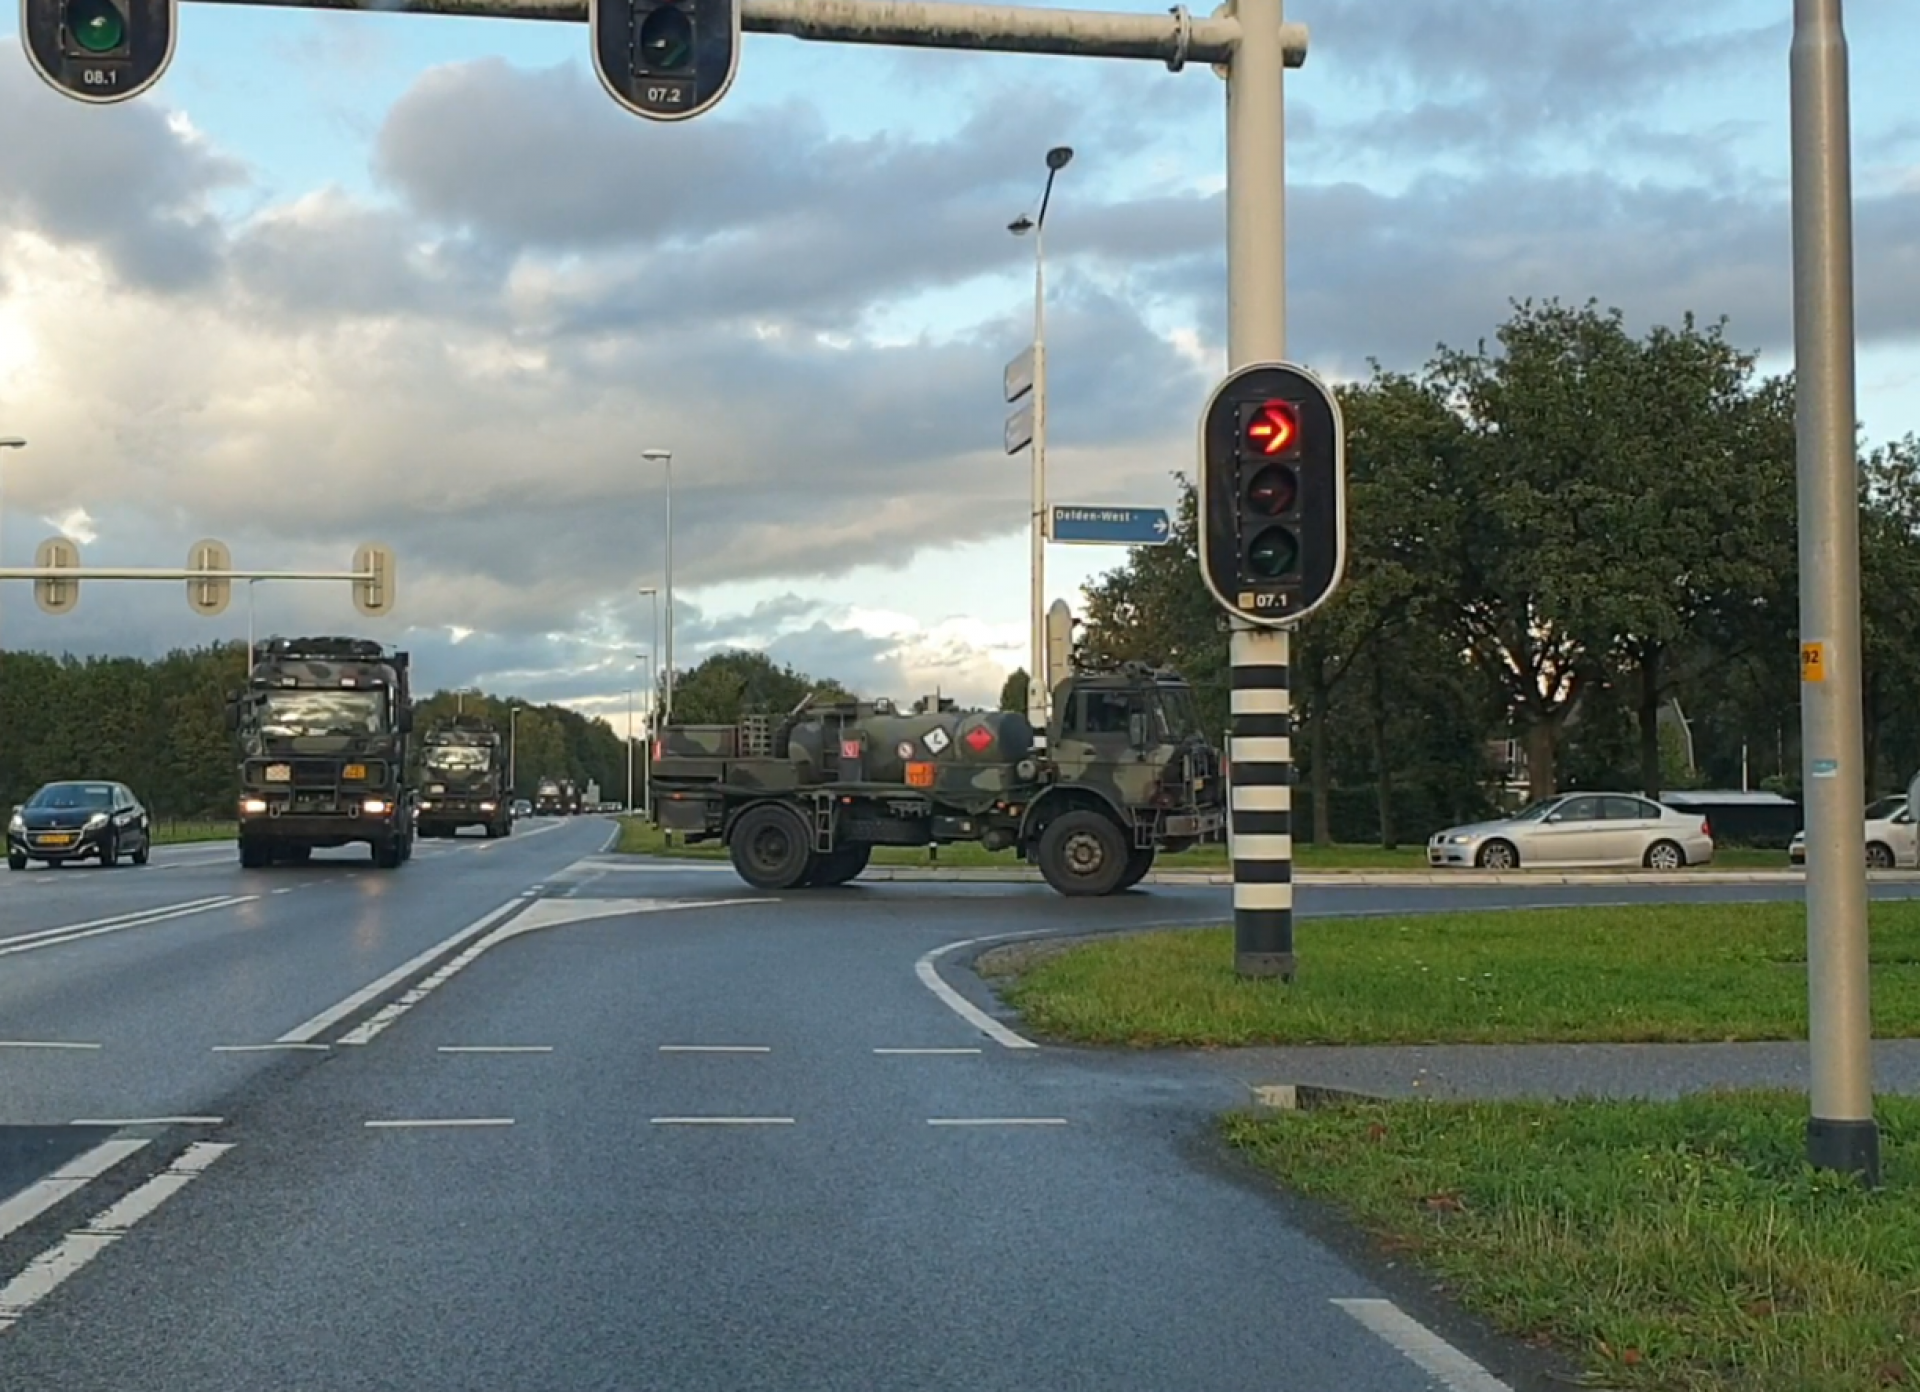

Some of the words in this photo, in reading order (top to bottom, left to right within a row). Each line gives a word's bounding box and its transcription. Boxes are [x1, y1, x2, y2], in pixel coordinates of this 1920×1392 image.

[84, 69, 116, 84] 08.1
[648, 87, 681, 102] 07.2
[1256, 593, 1287, 607] 07.1
